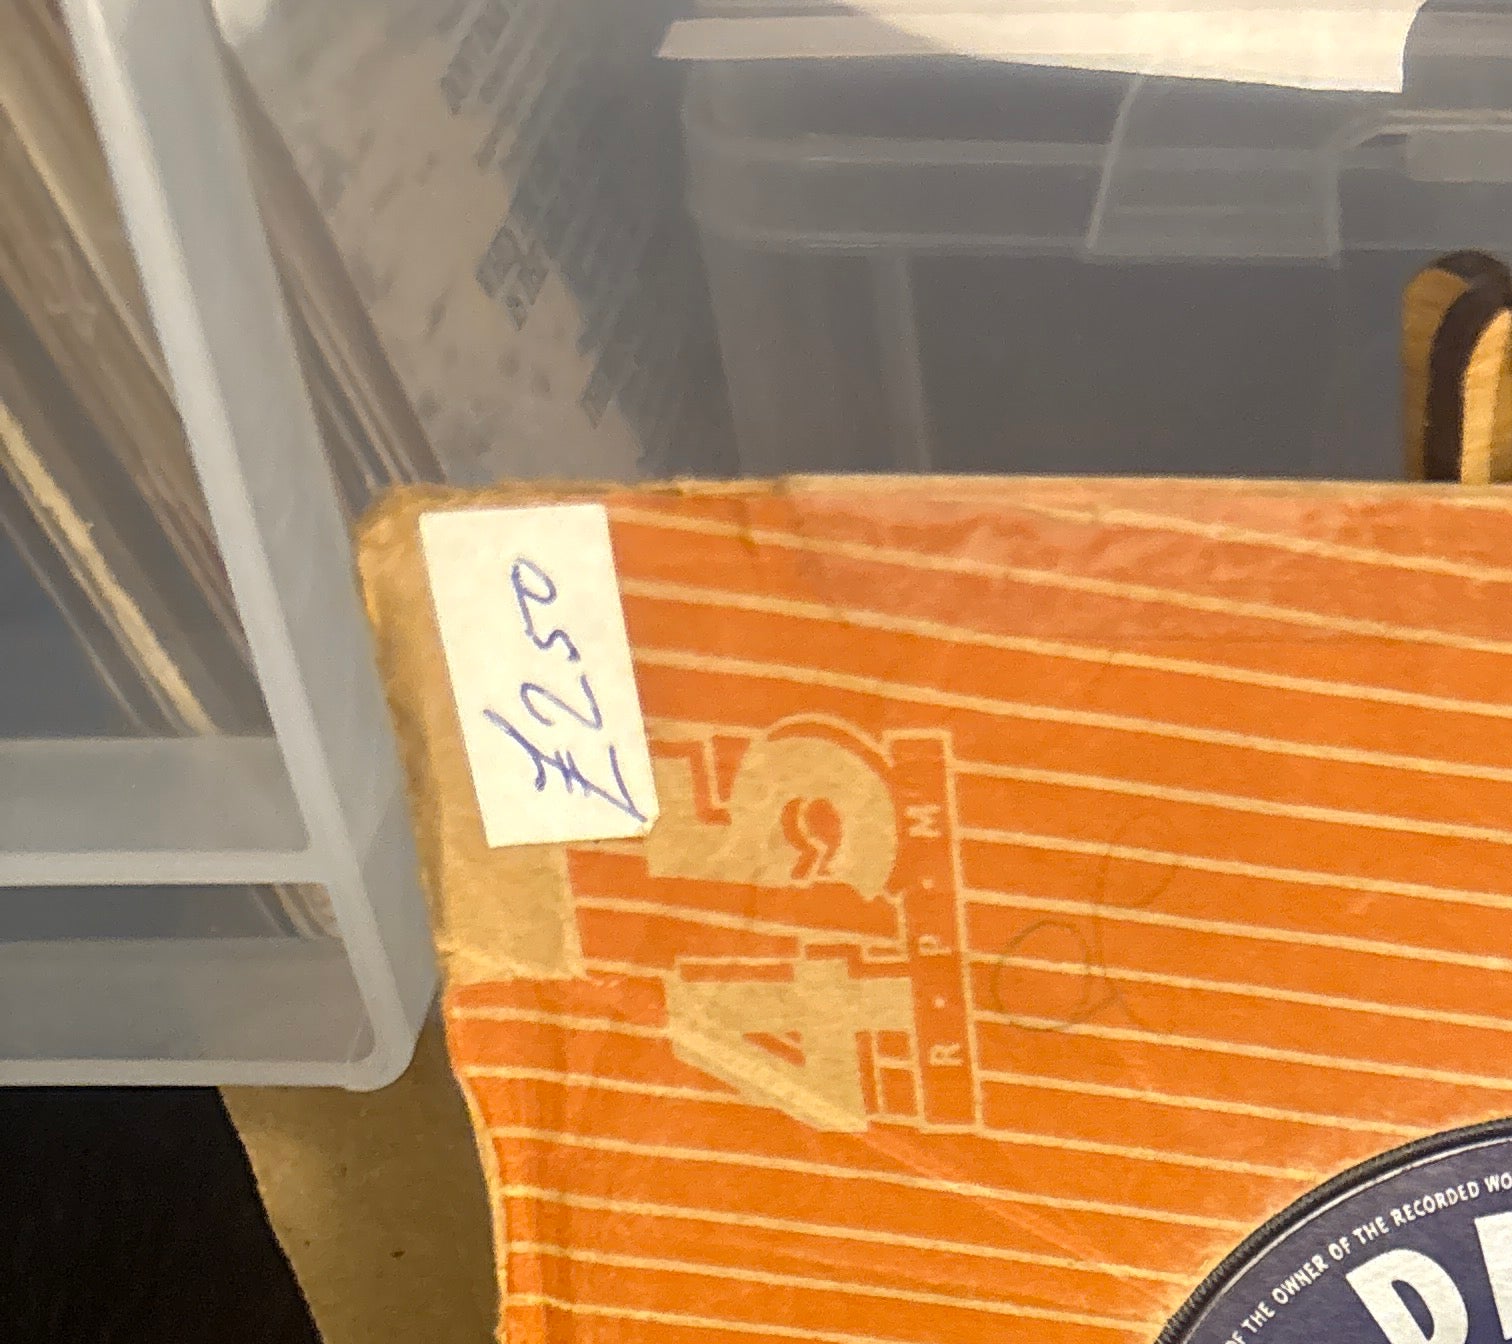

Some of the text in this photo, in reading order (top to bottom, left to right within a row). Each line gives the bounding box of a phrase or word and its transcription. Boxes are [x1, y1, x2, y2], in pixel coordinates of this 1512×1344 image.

[1241, 1301, 1275, 1334] THE
[1272, 1254, 1328, 1305] OWNER
[1328, 1236, 1351, 1261] OF
[1353, 1216, 1390, 1245] THE
[1390, 1181, 1480, 1227] RECORDED
